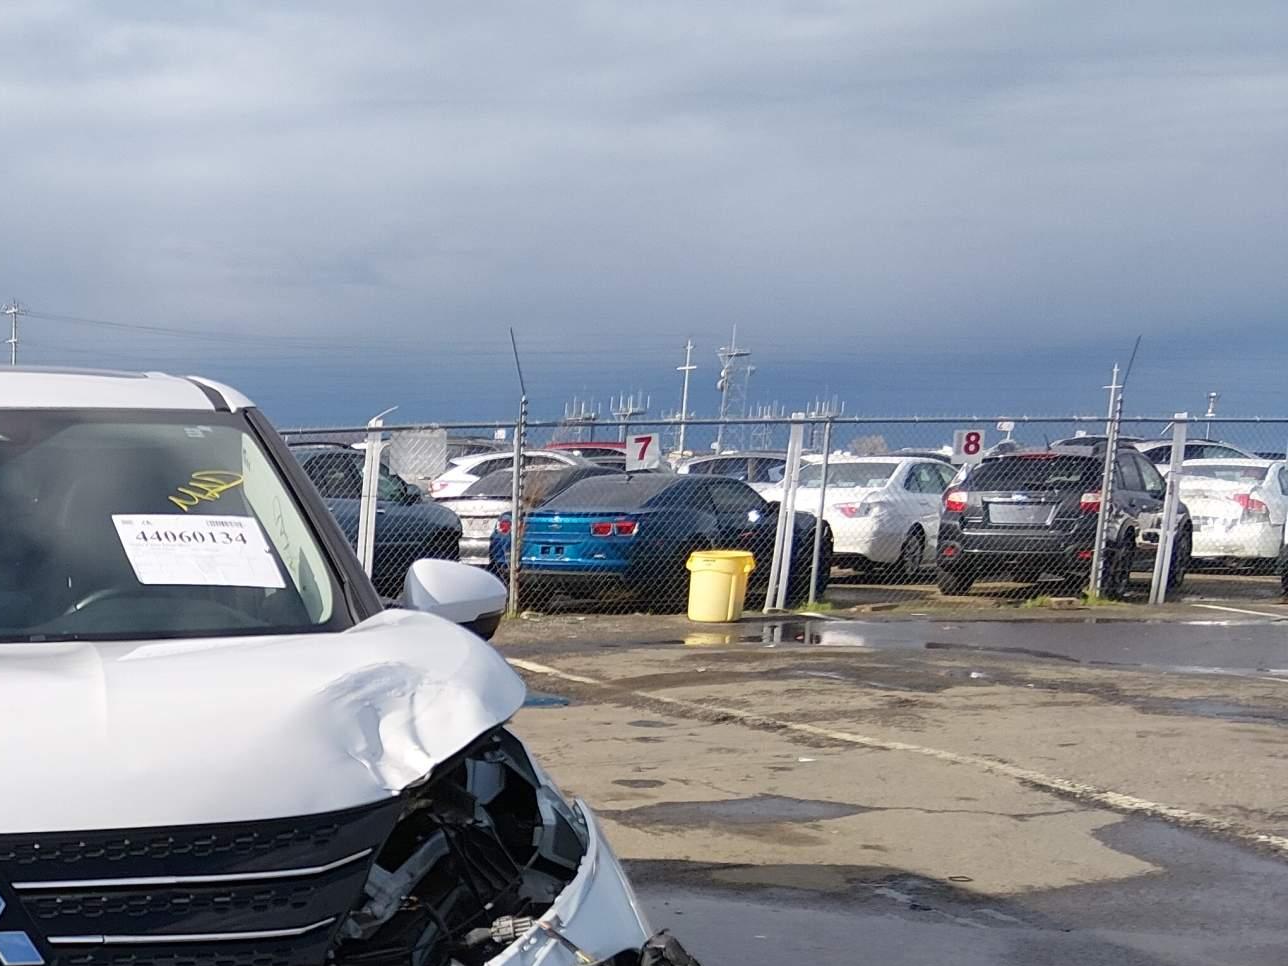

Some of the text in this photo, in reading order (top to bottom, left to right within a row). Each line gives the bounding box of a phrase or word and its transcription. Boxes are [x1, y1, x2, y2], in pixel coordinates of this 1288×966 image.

[634, 436, 652, 461] 7
[964, 432, 980, 455] 8
[136, 530, 247, 544] 44060134
